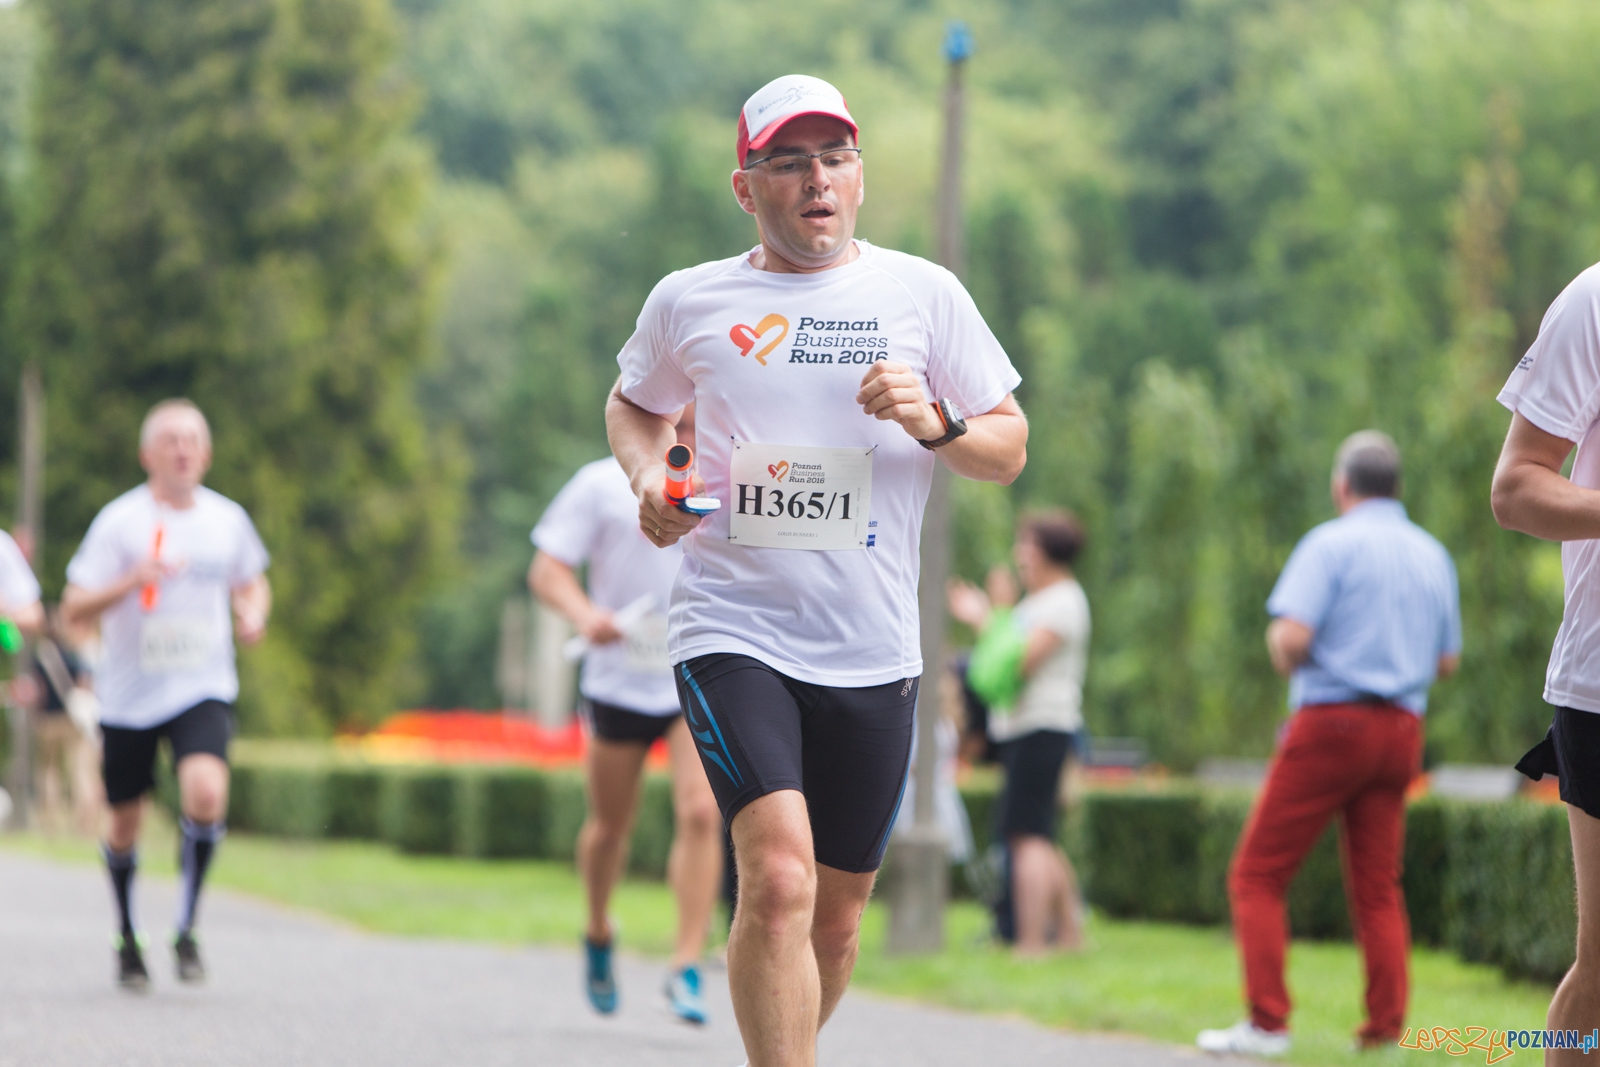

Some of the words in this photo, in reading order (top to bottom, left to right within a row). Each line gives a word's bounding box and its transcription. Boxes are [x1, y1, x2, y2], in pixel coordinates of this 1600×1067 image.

[797, 317, 879, 331] Poznań
[792, 333, 888, 349] Business
[788, 349, 834, 364] Run
[838, 350, 888, 364] 2016
[790, 469, 825, 477] Business
[791, 462, 822, 470] Poznań
[735, 483, 852, 520] H365/1
